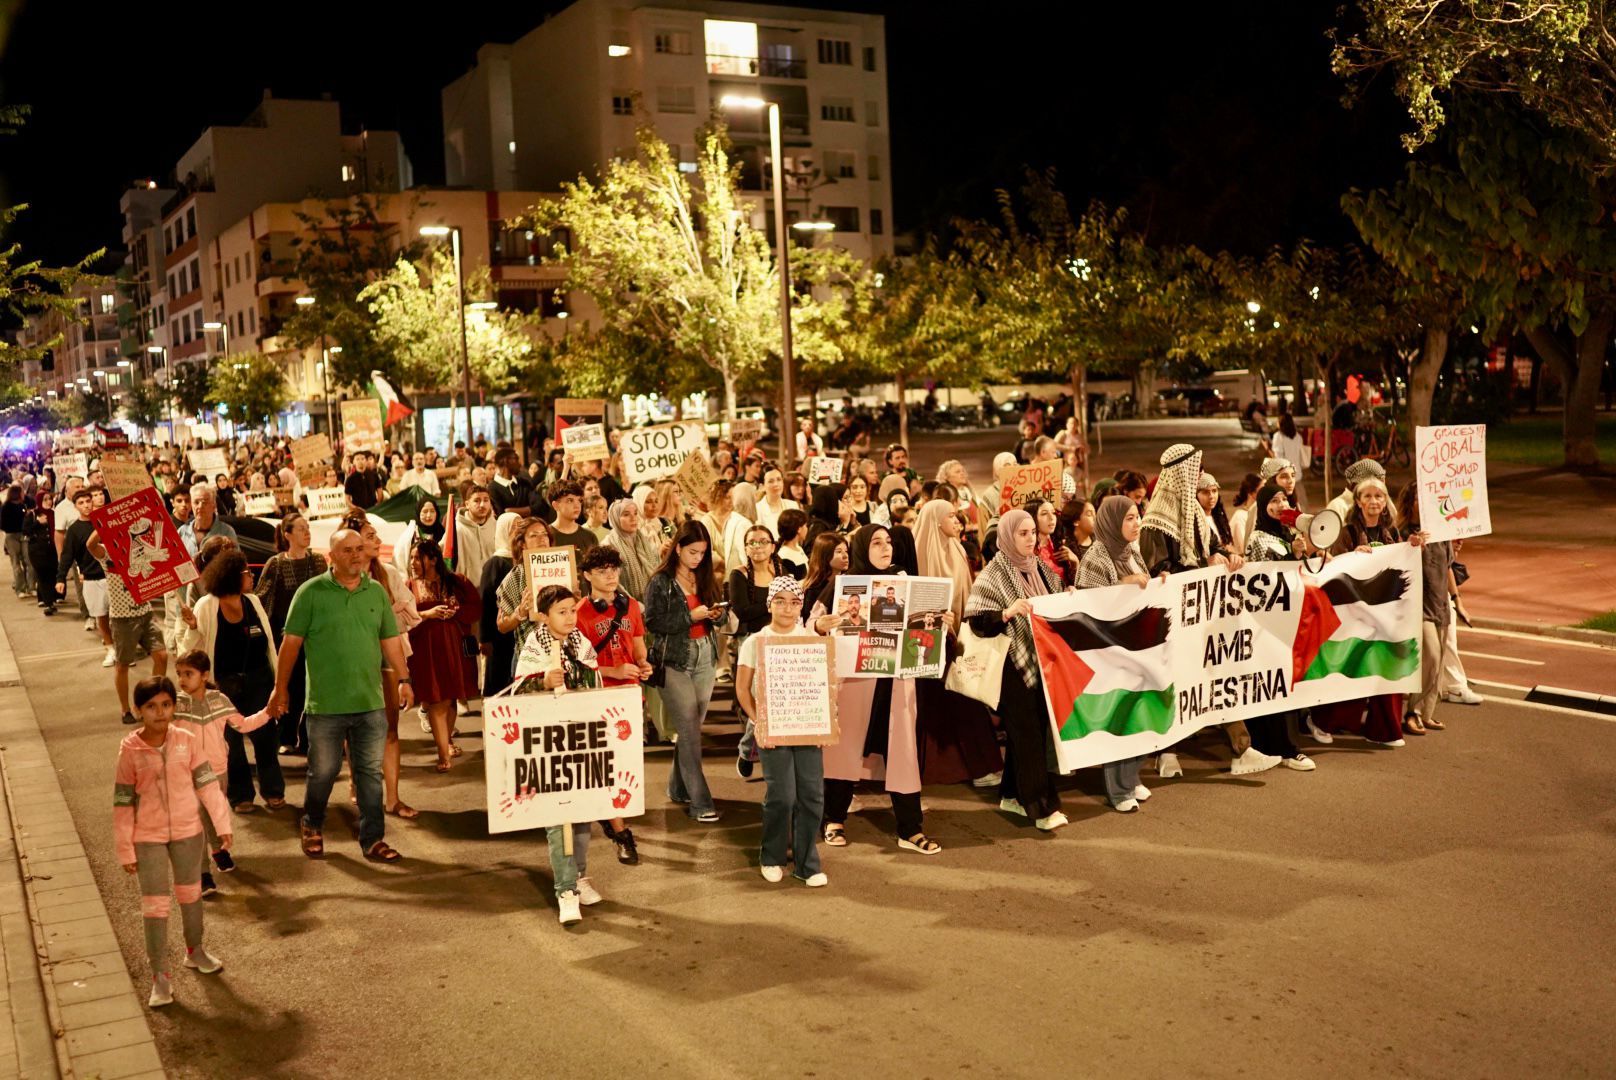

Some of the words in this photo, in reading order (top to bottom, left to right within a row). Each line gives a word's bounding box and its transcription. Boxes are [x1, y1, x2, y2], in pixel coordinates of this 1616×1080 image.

[630, 425, 685, 454] STOP
[634, 449, 691, 473] BOMBIN
[1421, 436, 1482, 473] GLOBAL
[1016, 466, 1052, 485] STOP
[106, 496, 140, 516] EIVISSA
[107, 504, 152, 529] PALESTINA
[533, 567, 567, 578] LIBRE
[1181, 571, 1291, 628] EIVISSA
[792, 647, 801, 655] EL
[859, 636, 896, 648] PALESTINA
[861, 647, 870, 657] NO
[1202, 628, 1254, 669] AMB
[861, 658, 889, 672] SOLA
[769, 674, 785, 682] POR
[1179, 667, 1288, 725] PALESTINA
[523, 720, 608, 756] FREE
[514, 750, 615, 797] PALESTINE
